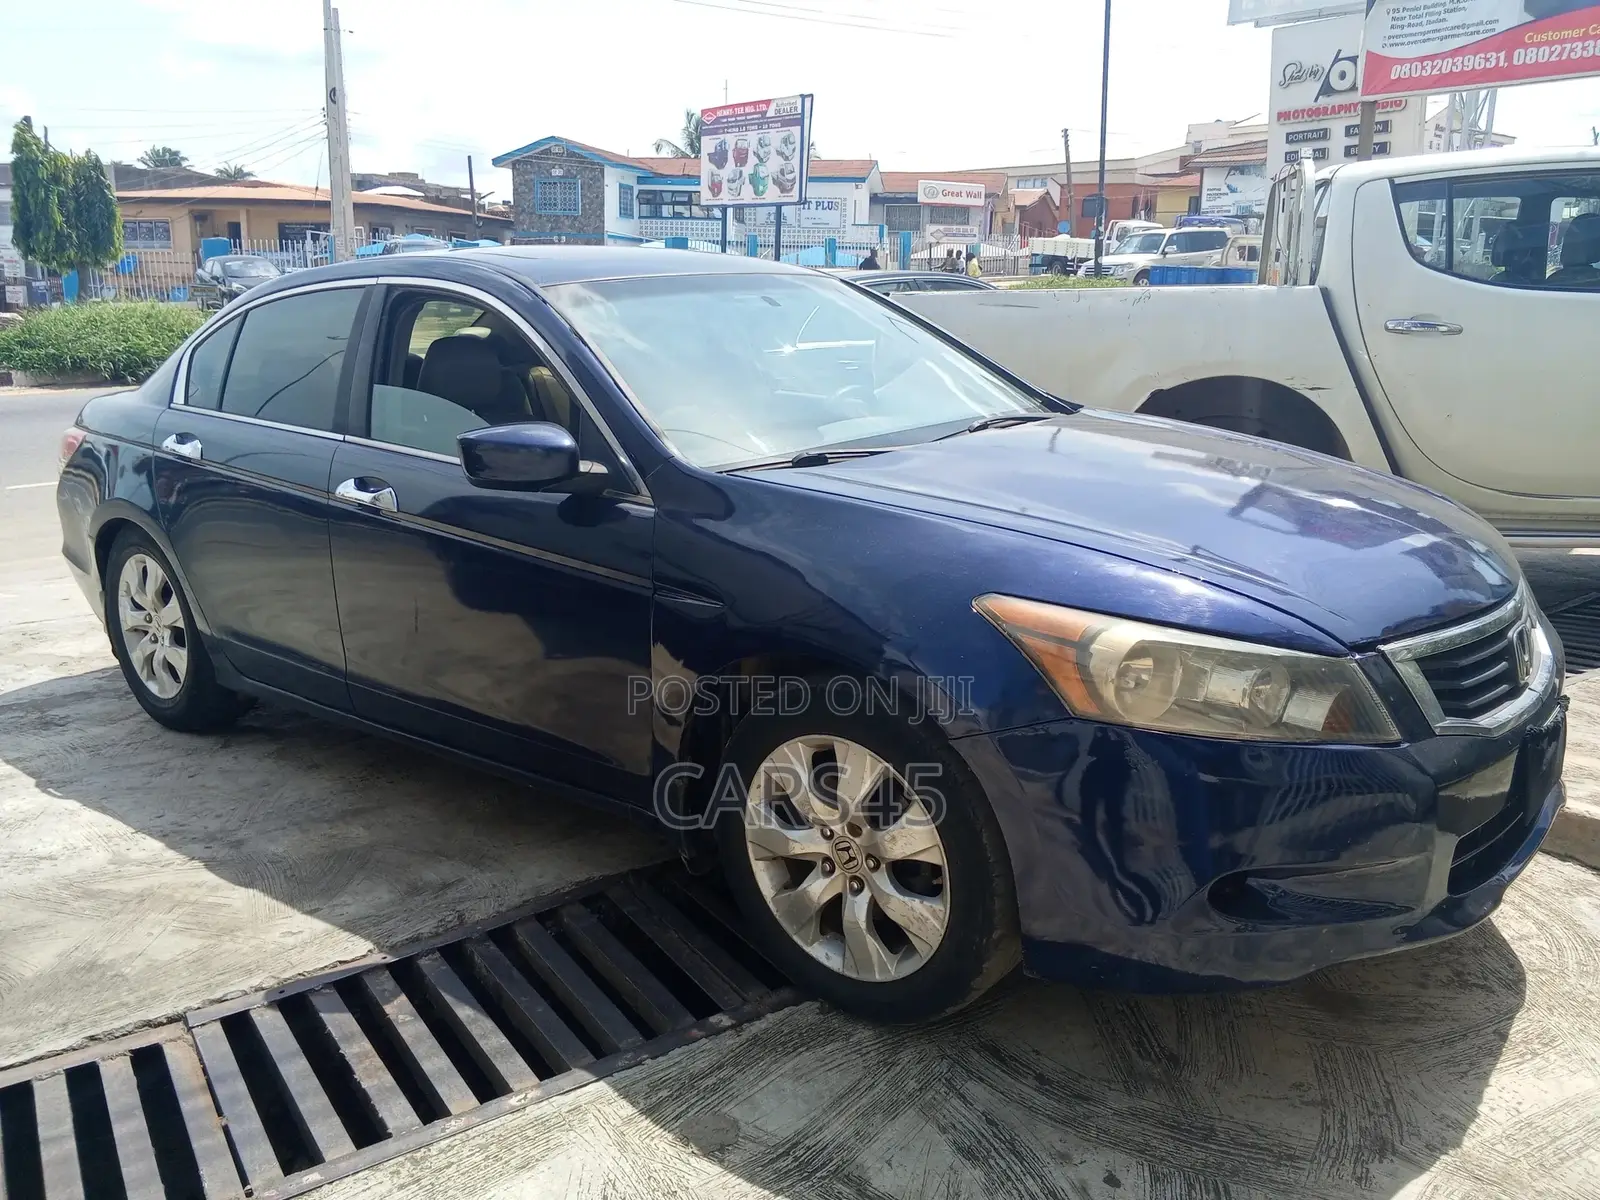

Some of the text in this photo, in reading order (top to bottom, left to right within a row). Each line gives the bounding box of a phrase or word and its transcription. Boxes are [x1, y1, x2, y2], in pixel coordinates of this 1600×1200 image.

[1391, 14, 1406, 22] Near
[1408, 11, 1424, 20] Total
[1524, 27, 1587, 44] Customer
[1390, 50, 1509, 80] 08032039631,
[774, 105, 799, 116] DEALER
[1276, 101, 1360, 122] PHOTOGRAPHY
[1288, 130, 1325, 141] PORTRAIT
[1286, 150, 1324, 161] EDIAL
[941, 188, 982, 200] Great Wall
[815, 200, 840, 211] PLUS
